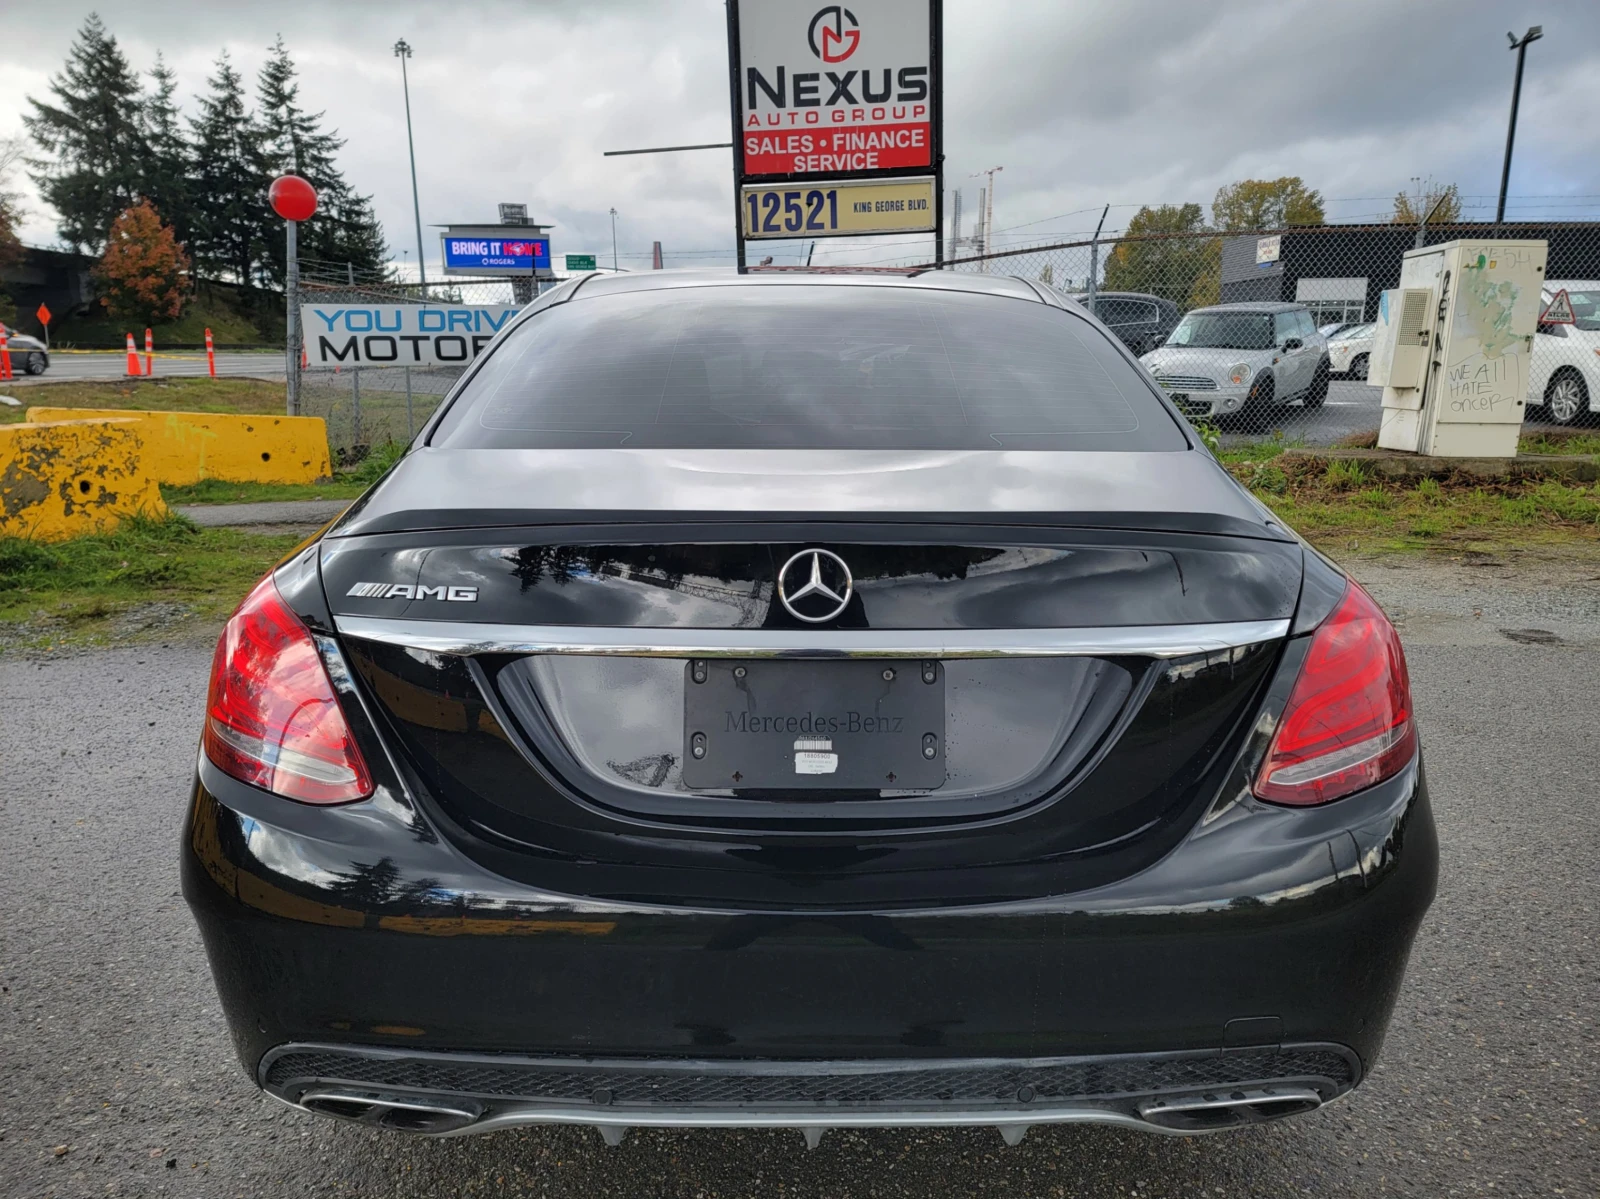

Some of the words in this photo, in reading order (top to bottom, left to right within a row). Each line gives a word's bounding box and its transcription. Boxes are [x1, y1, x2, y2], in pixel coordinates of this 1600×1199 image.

[747, 66, 927, 110] NEXUS
[747, 111, 819, 127] AUTO
[831, 105, 926, 123] GROUP
[746, 135, 814, 156] SALES
[832, 129, 925, 152] FINANCE
[793, 152, 879, 172] SERVICE
[747, 190, 838, 233] 12521
[853, 201, 872, 213] KING
[875, 200, 905, 213] GEORGE
[907, 199, 930, 211] BLVD.
[451, 241, 489, 256] BRING
[490, 241, 501, 256] IT
[313, 310, 402, 332] YOU
[1450, 364, 1471, 382] WE
[1450, 381, 1494, 398] HATE
[384, 583, 479, 602] AMG
[724, 711, 904, 734] Mercedes-Benz
